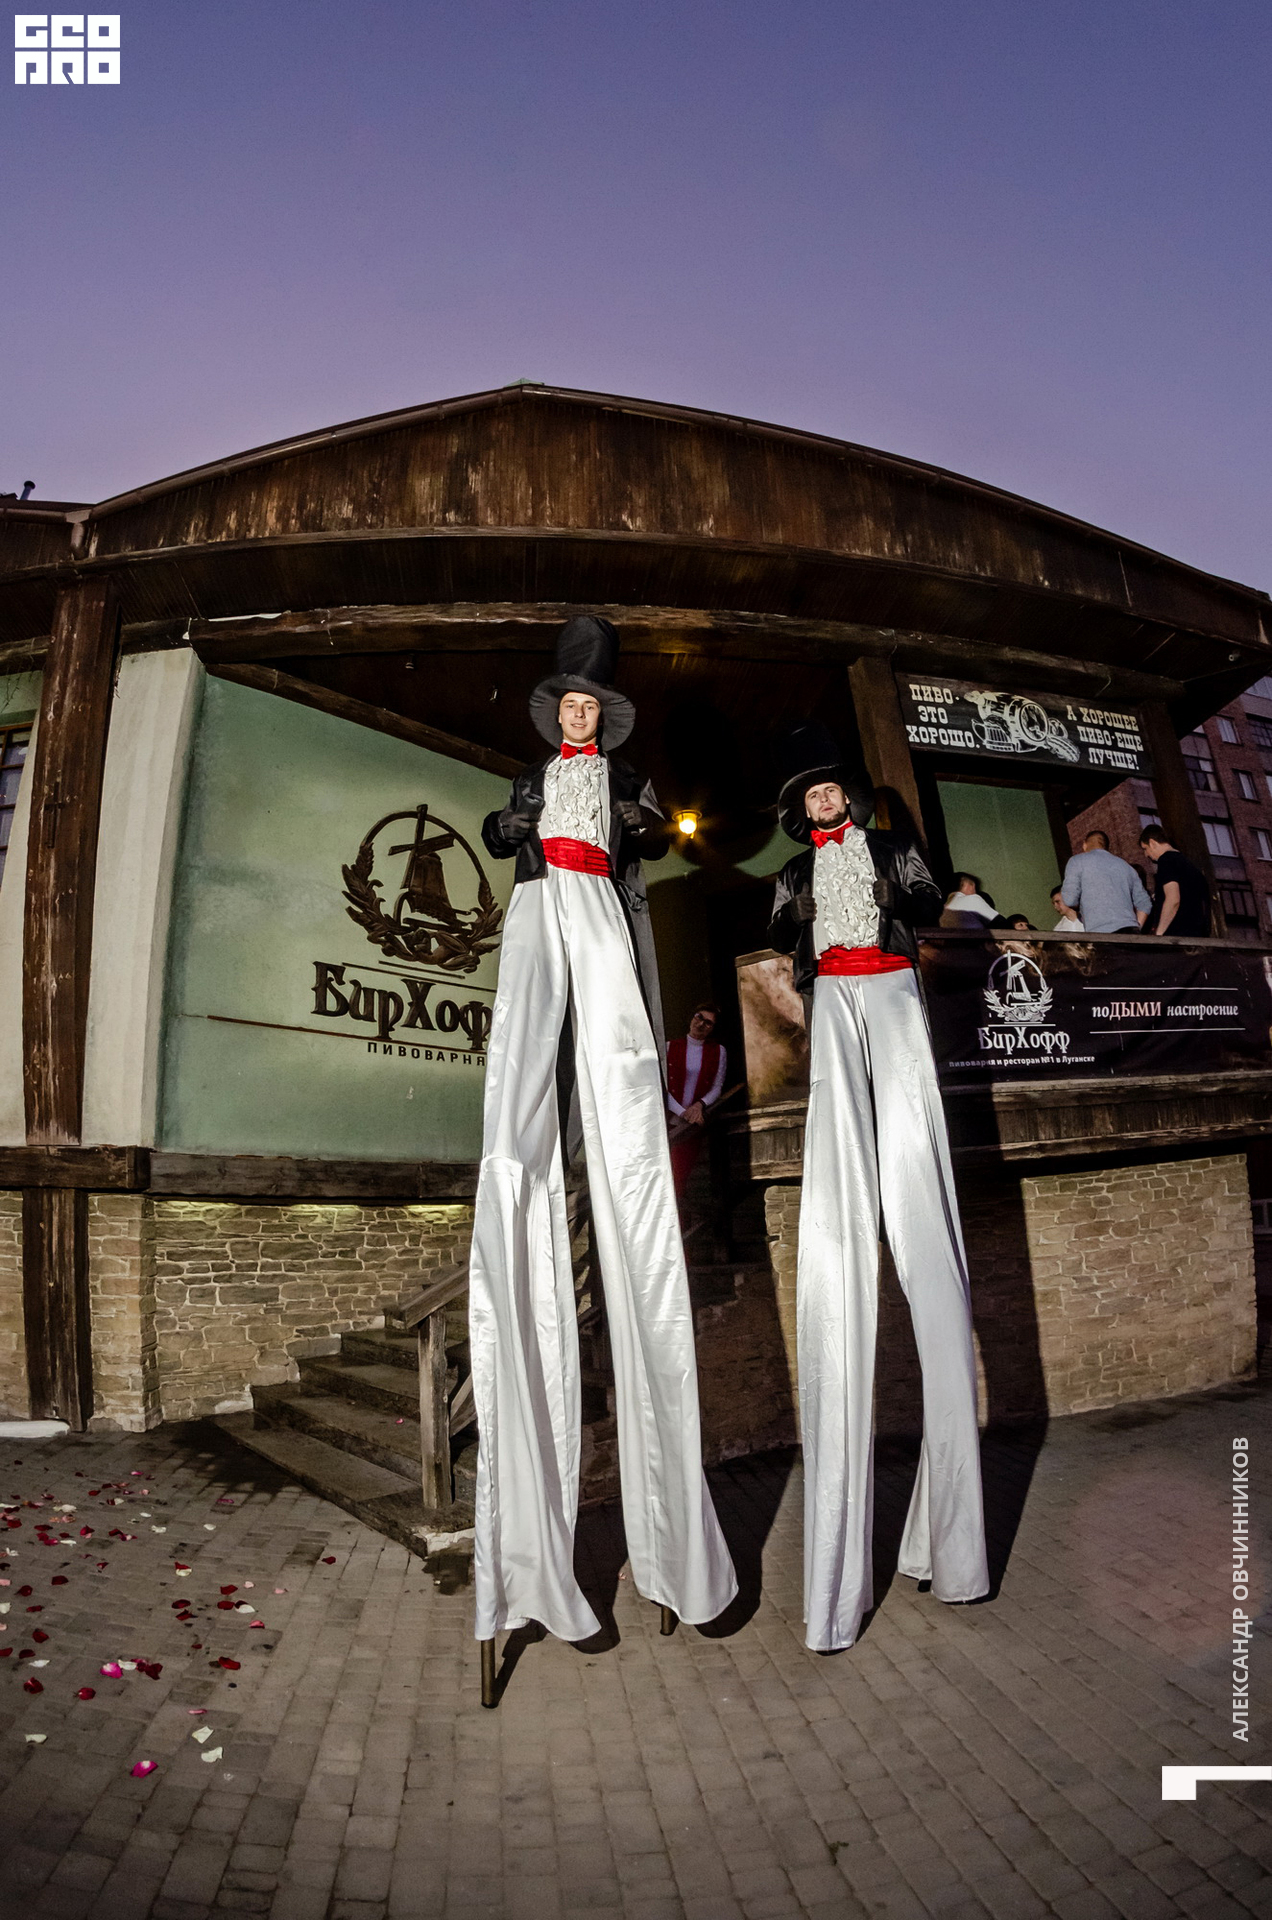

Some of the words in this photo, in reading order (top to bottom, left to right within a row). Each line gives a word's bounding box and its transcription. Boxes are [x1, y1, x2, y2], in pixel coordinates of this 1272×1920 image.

[918, 705, 948, 724] ЭТО
[1066, 704, 1077, 721] А
[1079, 707, 1139, 731] ХОРОШЕЕ
[906, 725, 980, 748] ХОРОШО.
[1088, 747, 1139, 770] ЛУЧШЕ!
[311, 961, 493, 1050] БирХоф
[1092, 1001, 1162, 1021] поДЫМИ
[1166, 1004, 1239, 1020] настроение
[977, 1026, 1070, 1055] БирХофф
[367, 1042, 486, 1066] ПИВОВАРНЯ
[1003, 1058, 1040, 1067] ресторан
[1061, 1055, 1096, 1065] Луганске
